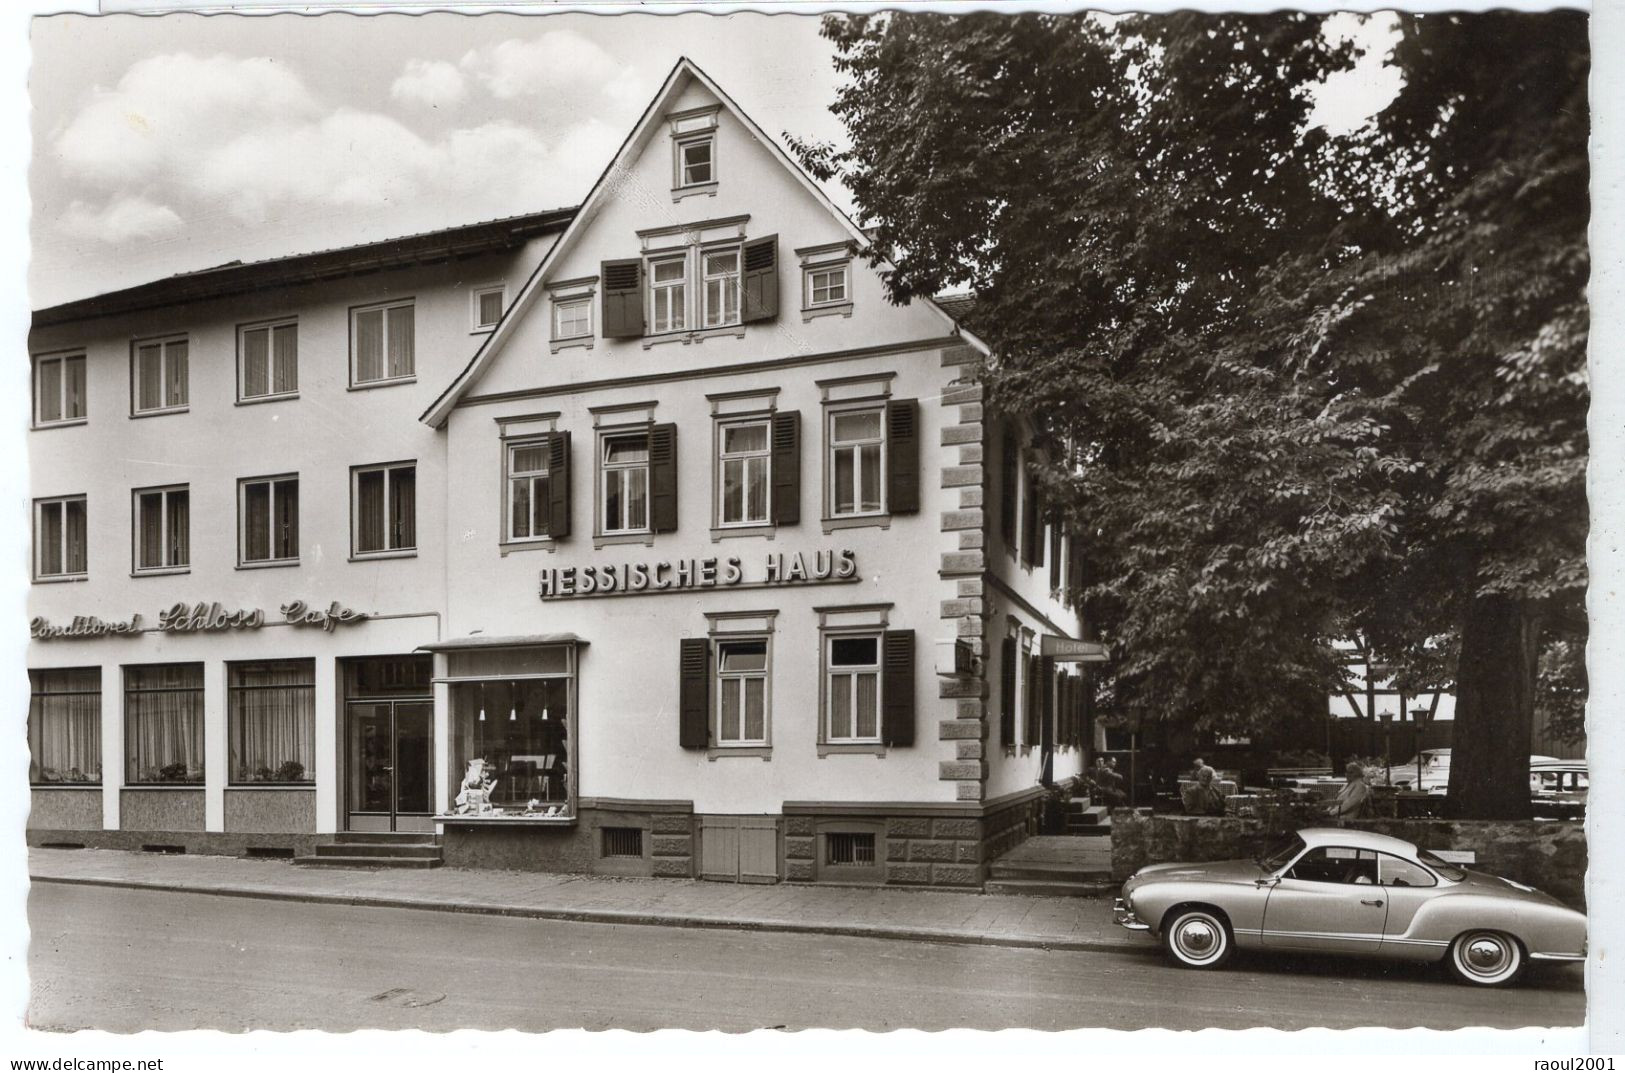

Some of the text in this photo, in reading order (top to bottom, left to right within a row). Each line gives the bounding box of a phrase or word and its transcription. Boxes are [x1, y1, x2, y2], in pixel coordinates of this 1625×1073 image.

[538, 549, 856, 597] HESSISCHES HAUS
[159, 601, 264, 632] Schloss
[1055, 641, 1088, 654] Hotel
